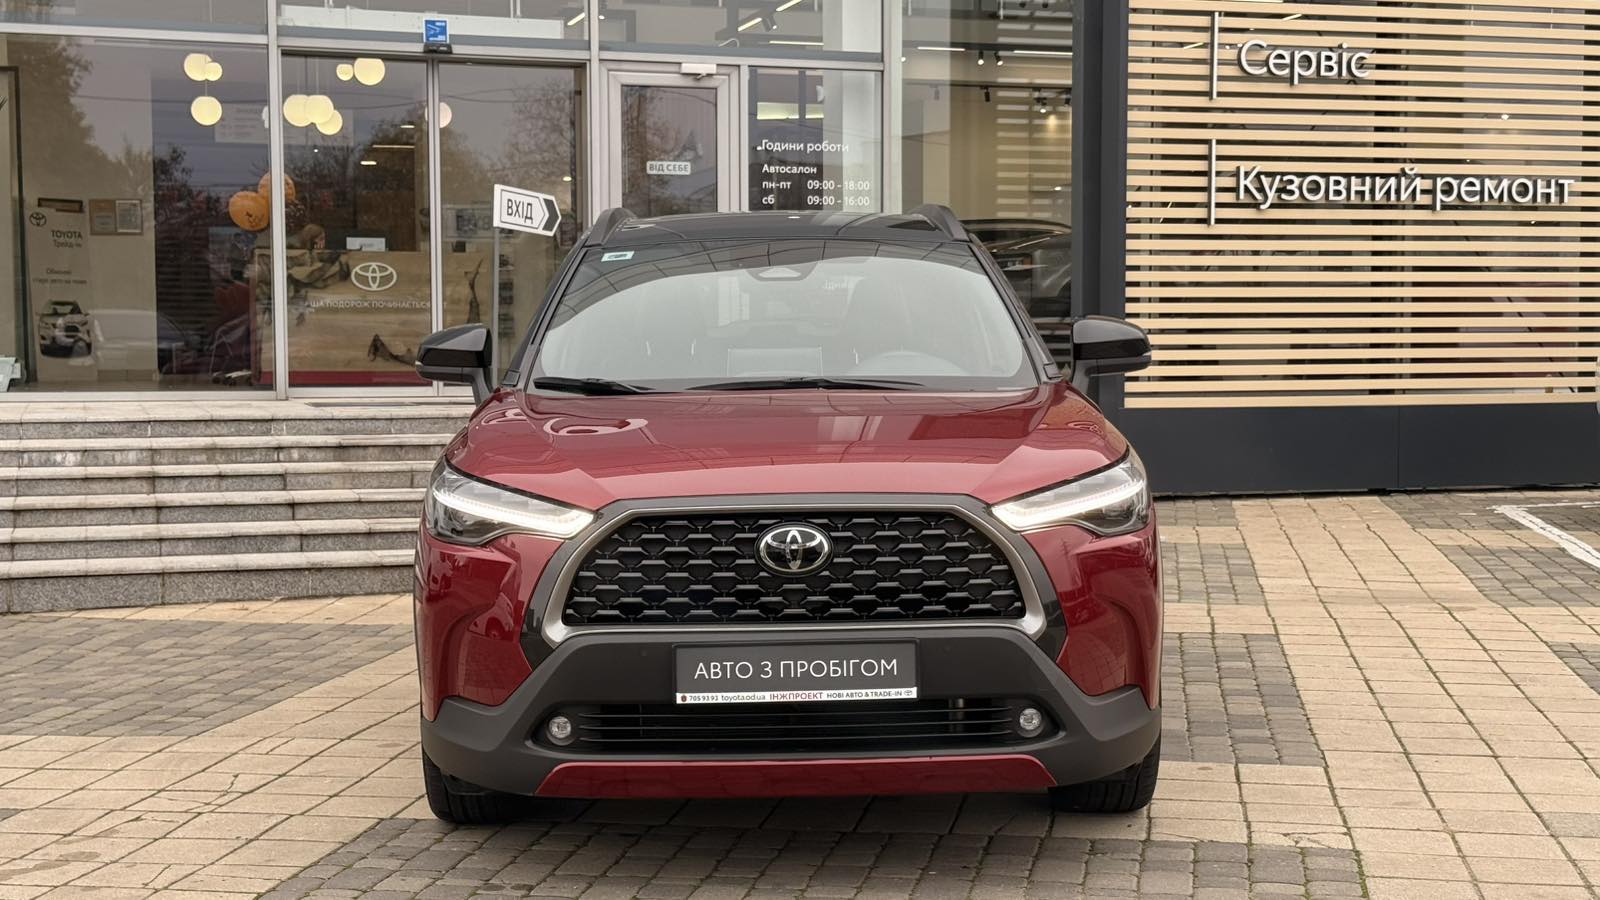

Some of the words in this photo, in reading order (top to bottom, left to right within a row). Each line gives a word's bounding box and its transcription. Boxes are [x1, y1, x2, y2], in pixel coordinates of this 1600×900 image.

[1239, 39, 1370, 86] Сервіс
[762, 139, 805, 153] Години
[806, 140, 849, 154] роботи
[649, 163, 664, 172] ВІД
[666, 163, 689, 172] СЕБЕ
[762, 164, 817, 174] Автосалон
[762, 181, 792, 190] пн-пт
[807, 180, 835, 190] 09:00
[844, 180, 870, 191] 18:00
[1238, 165, 1422, 210] Кузовний
[1434, 175, 1575, 211] ремонт
[762, 194, 775, 205] сб
[807, 195, 835, 206] 09:00
[844, 196, 870, 206] 16:00
[507, 199, 533, 224] ВХІД
[51, 230, 82, 239] TOYOTA
[327, 300, 368, 309] ПОДОРОЖ
[694, 661, 753, 679] АВТО
[760, 661, 773, 679] З
[780, 658, 897, 678] ПРОБІГОМ
[769, 691, 824, 701] ІНЖПРОЕКТ
[871, 690, 903, 698] TRADE-IN
